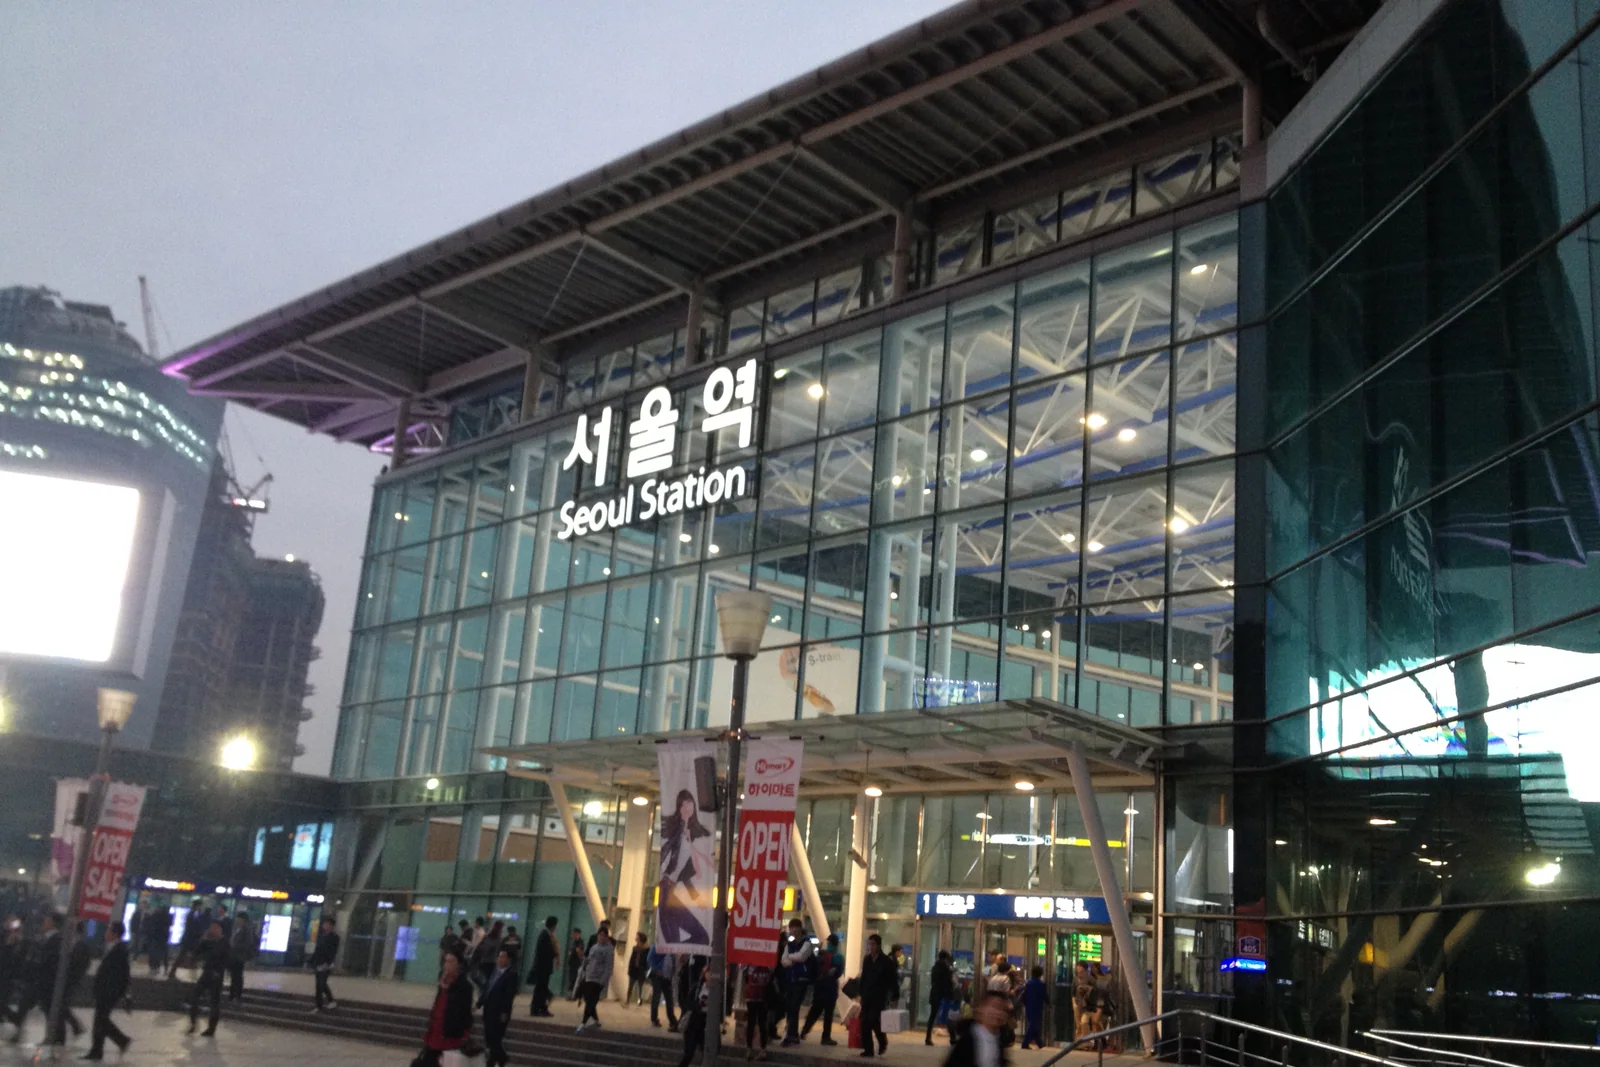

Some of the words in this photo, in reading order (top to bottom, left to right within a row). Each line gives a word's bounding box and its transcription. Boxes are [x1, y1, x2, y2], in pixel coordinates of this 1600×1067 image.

[563, 358, 757, 487] 서울역
[557, 484, 634, 540] Seoul
[639, 466, 746, 521] Station
[748, 783, 795, 797] 하이마트
[740, 820, 793, 871] OPEN
[733, 876, 787, 930] SALE
[923, 894, 930, 914] 1
